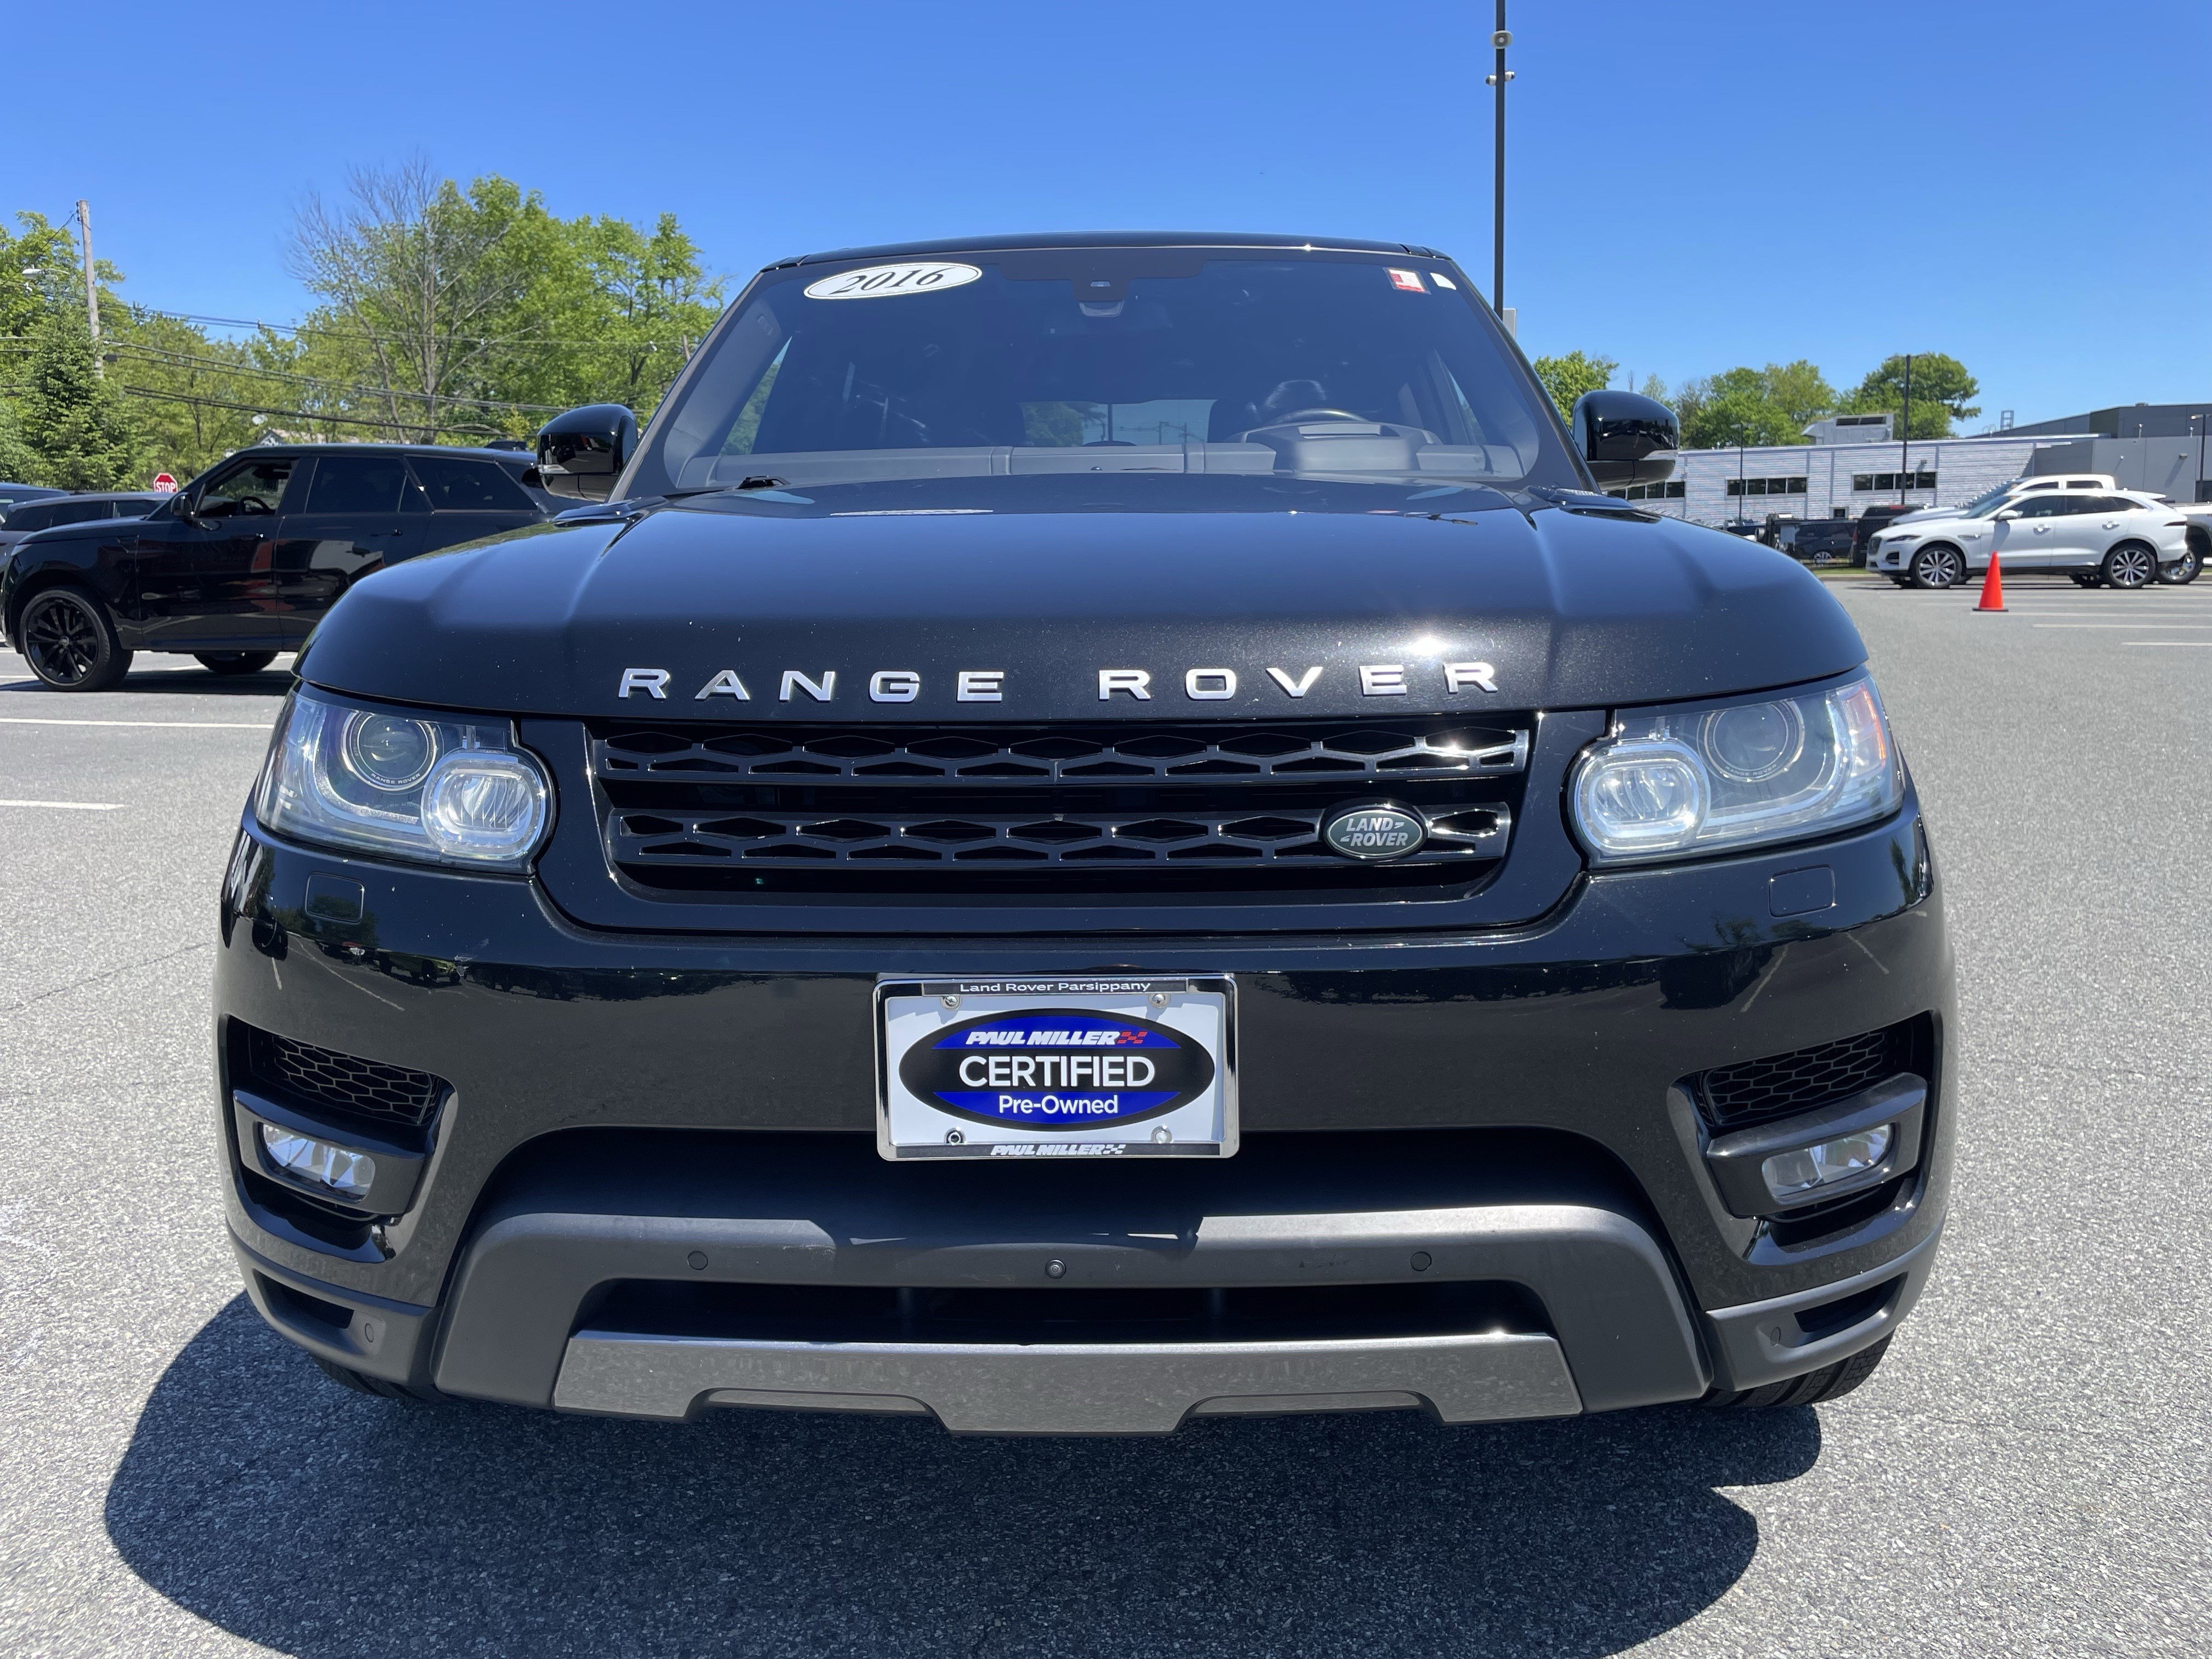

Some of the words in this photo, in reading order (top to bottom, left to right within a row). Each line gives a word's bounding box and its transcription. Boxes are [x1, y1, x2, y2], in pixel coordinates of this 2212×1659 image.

[829, 267, 955, 295] 2016
[156, 482, 176, 493] STOP
[618, 668, 1005, 702] RANGE
[1099, 662, 1498, 701] ROVER
[371, 773, 396, 784] RANGE
[398, 773, 421, 784] ROVER
[1346, 817, 1393, 832] LAND
[1350, 832, 1409, 847] ROVER
[960, 984, 1000, 992] Land
[1006, 984, 1054, 992] Rover
[1058, 983, 1150, 992] Parsippany
[965, 1031, 1025, 1045] PAUL
[1026, 1031, 1118, 1045] MILLER
[959, 1056, 1155, 1087] CERTIFIED
[999, 1094, 1119, 1114] Pre-Owned
[991, 1145, 1035, 1155] PAUL
[1037, 1144, 1105, 1155] MILLER
